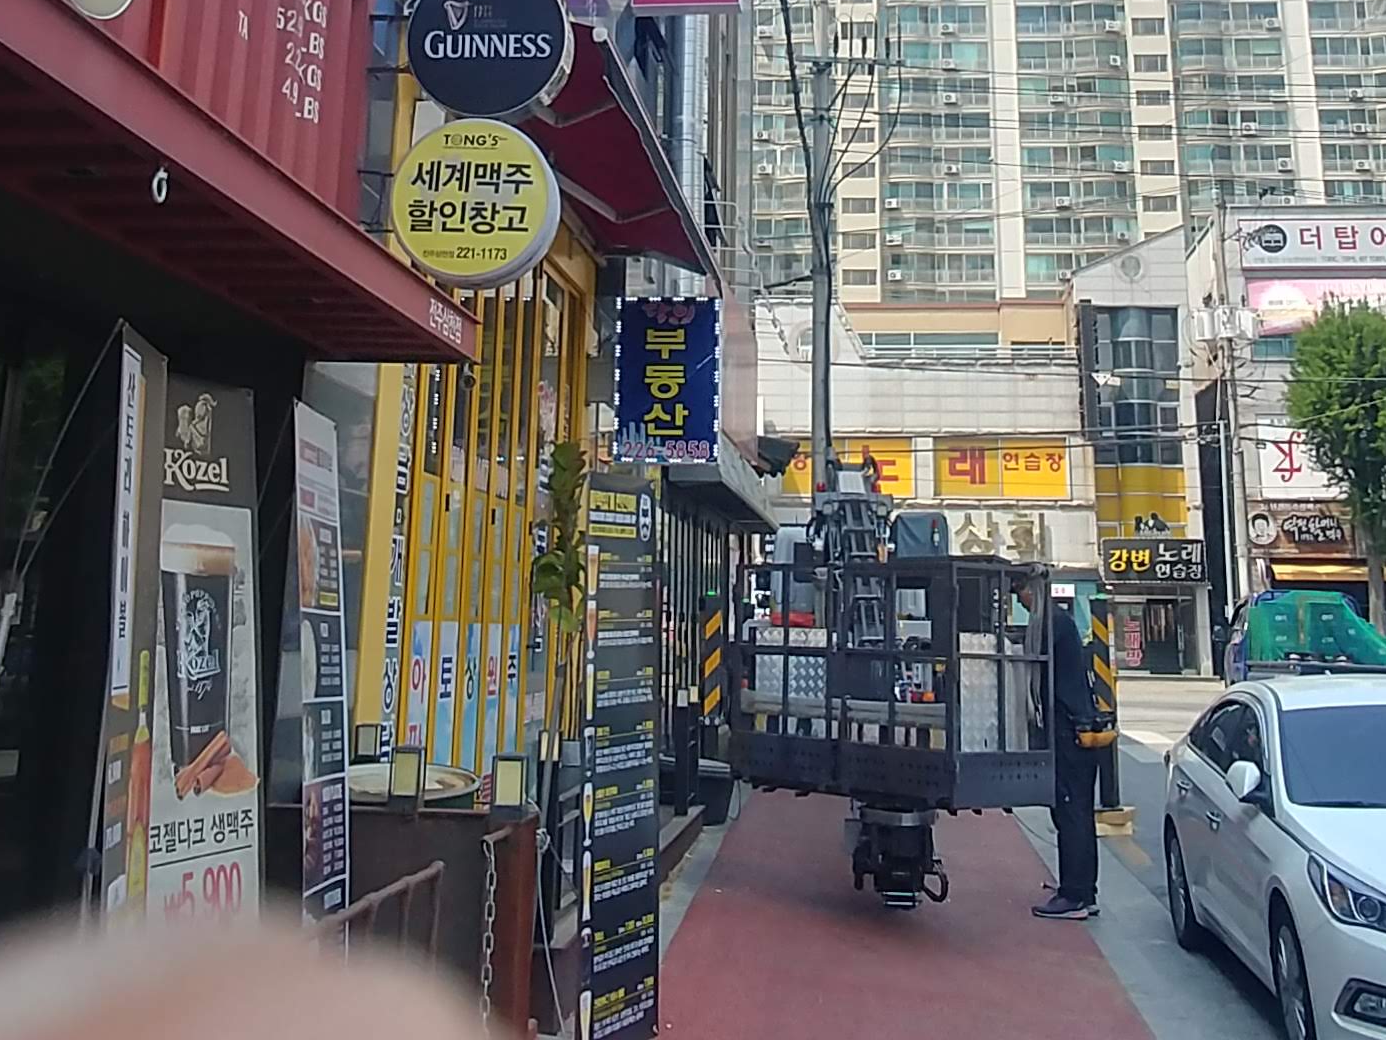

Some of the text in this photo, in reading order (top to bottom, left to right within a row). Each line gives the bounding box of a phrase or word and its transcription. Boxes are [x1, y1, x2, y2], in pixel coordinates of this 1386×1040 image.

[424, 31, 551, 58] GUINNESS
[411, 160, 533, 194] 세계맥주
[408, 199, 528, 234] 할인창고
[456, 247, 507, 260] 221-1173
[644, 328, 689, 436] 부동산
[623, 440, 710, 460] 226-5858
[1002, 451, 1064, 473] 연습장
[163, 447, 230, 492] Kozel
[1108, 543, 1202, 572] 강변 노래
[1155, 564, 1202, 579] 연습장
[149, 809, 254, 855] 코젤다크 생맥주
